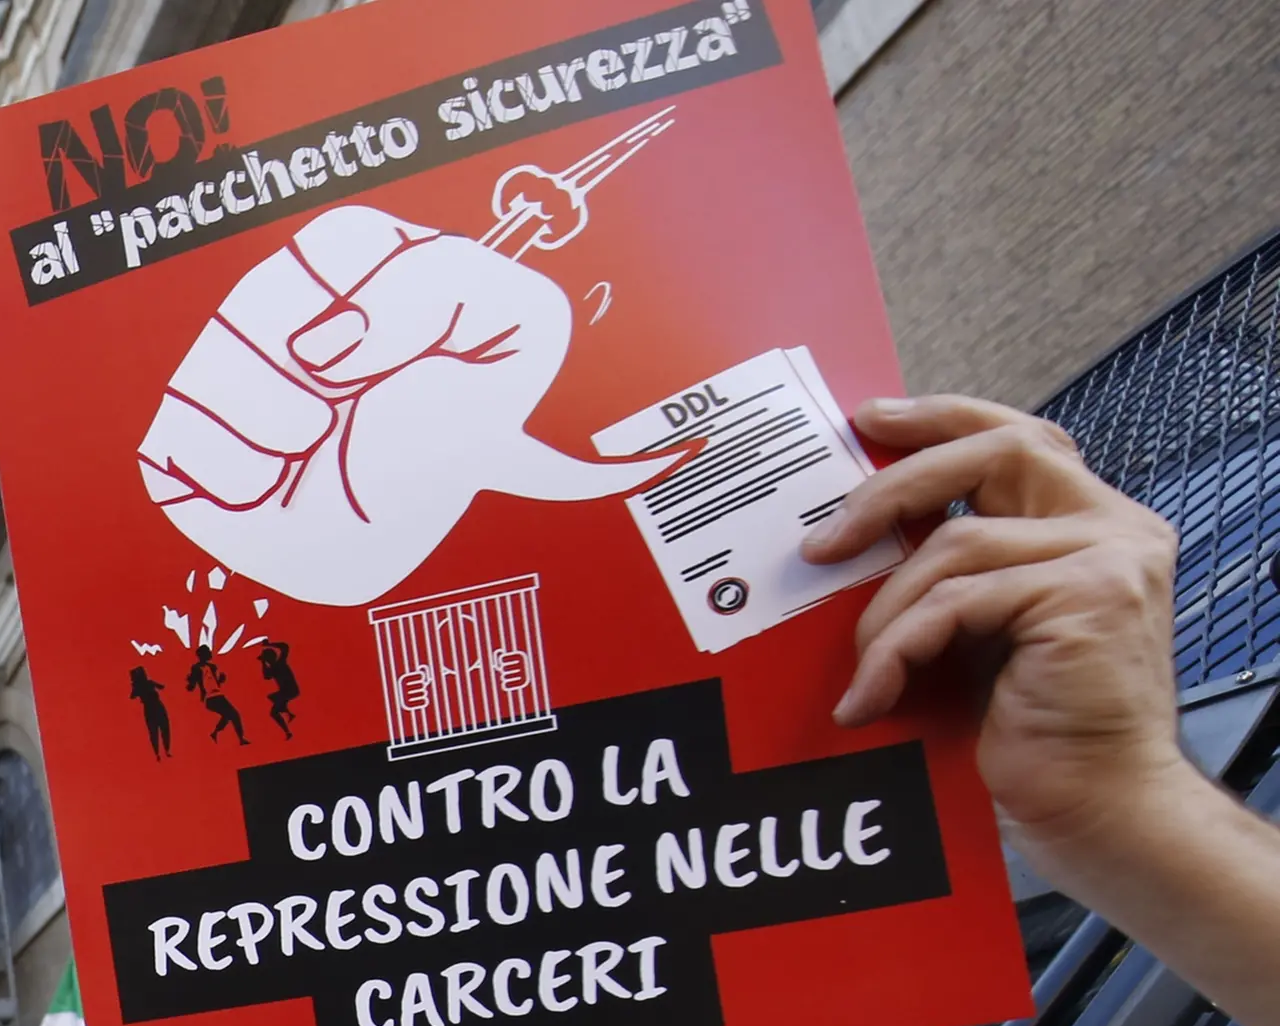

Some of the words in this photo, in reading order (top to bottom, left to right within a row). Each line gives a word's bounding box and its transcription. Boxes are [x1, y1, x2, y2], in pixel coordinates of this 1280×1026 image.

[28, 220, 81, 286] al
[90, 117, 421, 269] "pacchetto
[437, 0, 752, 142] sicurezza"
[38, 76, 233, 213] NO!
[660, 382, 729, 430] DDL
[287, 758, 575, 864] CONTRO
[602, 737, 691, 807] LA
[147, 843, 632, 977] REPRESSIONE
[654, 799, 891, 895] NELLE
